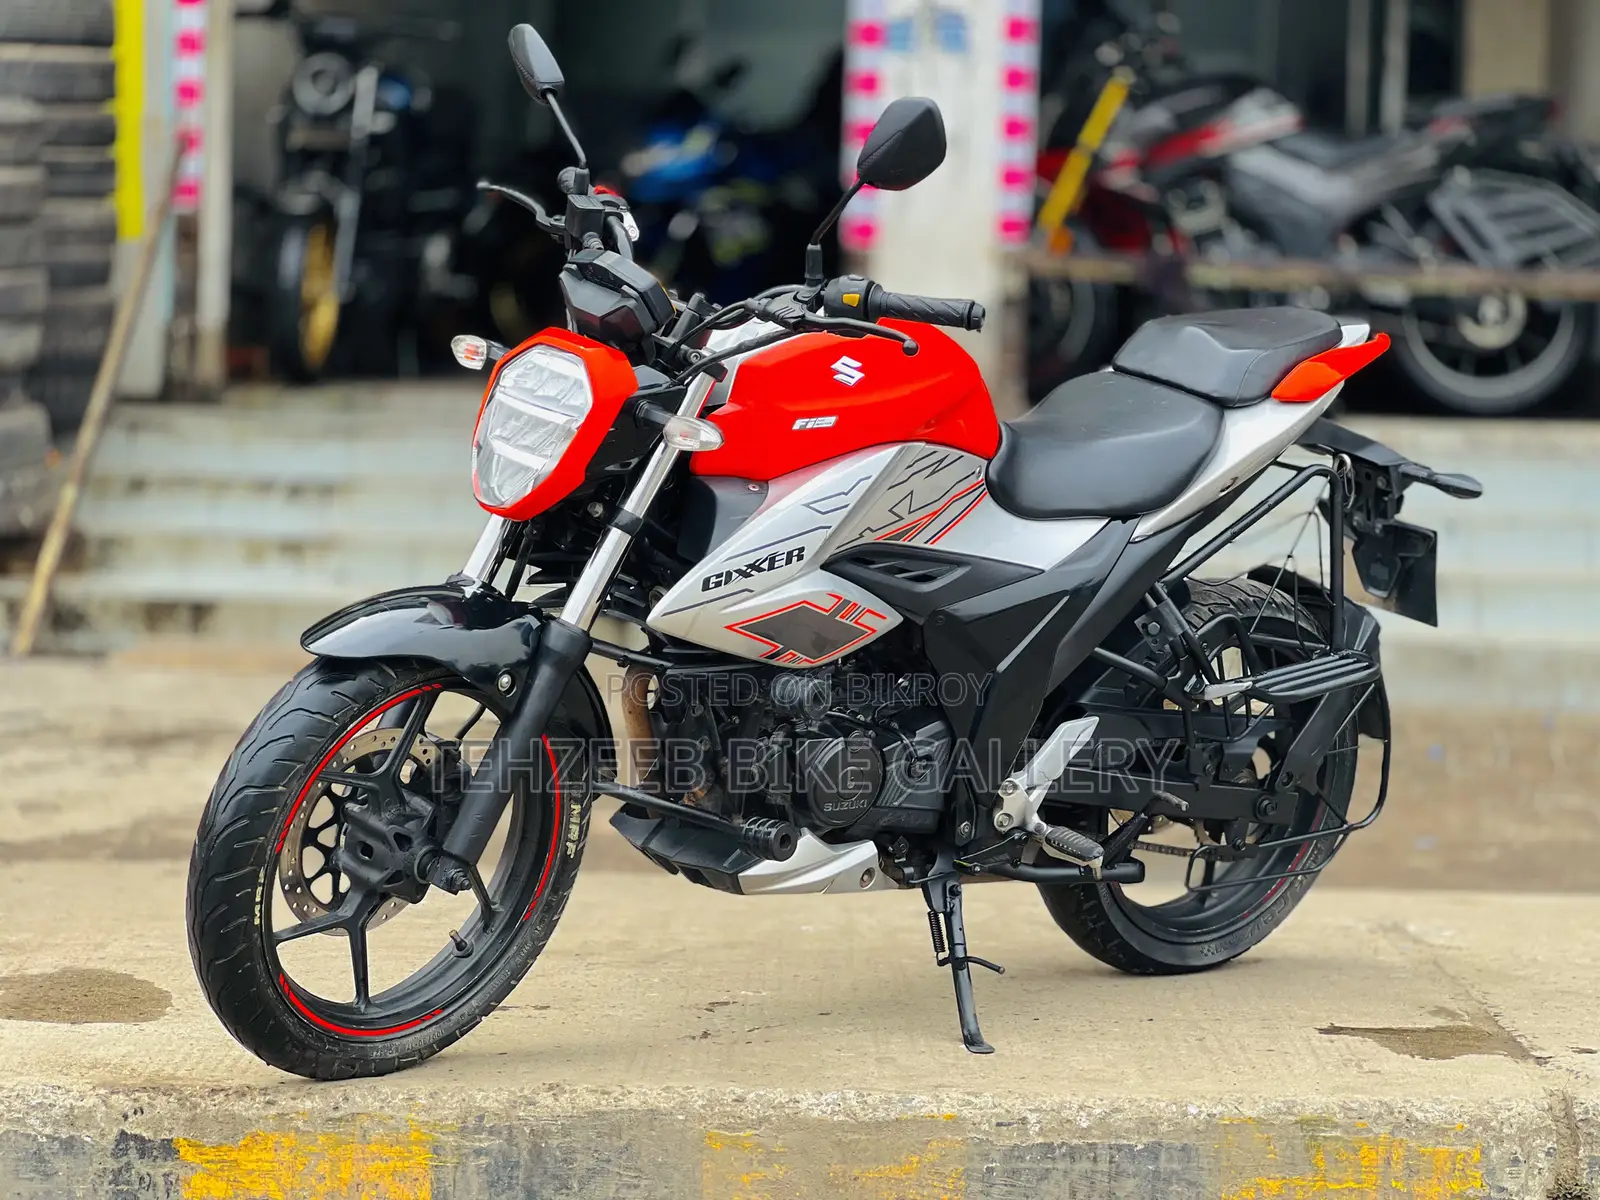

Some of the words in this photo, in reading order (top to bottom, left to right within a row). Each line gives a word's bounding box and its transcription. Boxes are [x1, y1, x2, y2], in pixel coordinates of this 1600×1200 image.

[701, 546, 806, 592] GIXXER
[823, 799, 868, 812] SUZUKI
[563, 803, 582, 859] MRF
